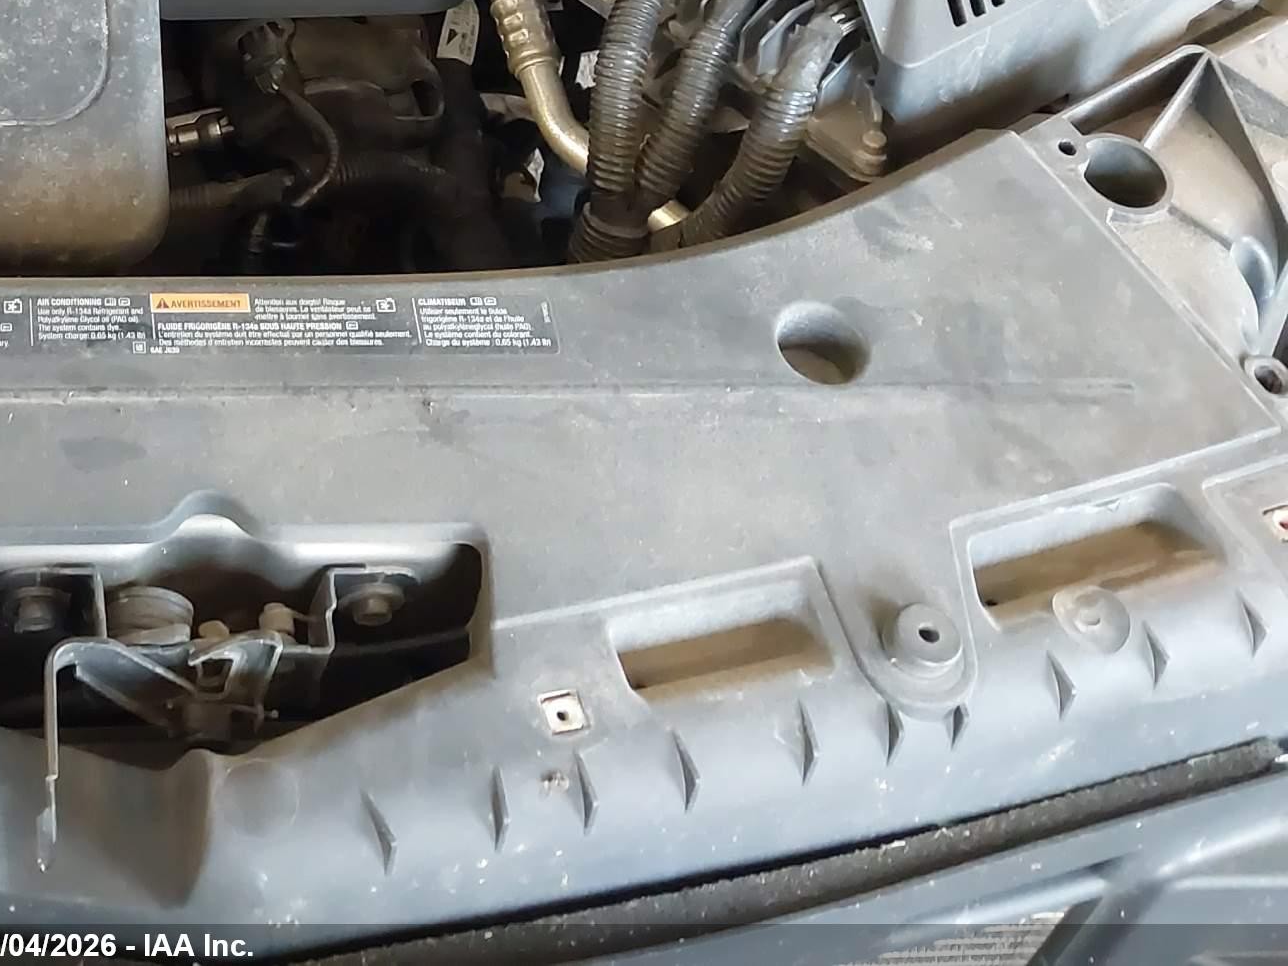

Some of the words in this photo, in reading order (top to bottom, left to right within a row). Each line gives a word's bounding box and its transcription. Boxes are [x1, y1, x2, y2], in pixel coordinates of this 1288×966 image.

[37, 298, 50, 307] AIR
[51, 298, 102, 307] CONDITIONING
[171, 299, 241, 309] AVERTISSEMENT
[418, 298, 466, 306] CLIMATISEUR
[37, 307, 50, 315] Use
[51, 307, 65, 316] only
[66, 307, 91, 315] R-134a
[92, 307, 130, 316] Refrigerant
[130, 307, 144, 315] and
[255, 306, 264, 314] de
[79, 315, 100, 324] Glycol
[101, 315, 110, 323] oil
[458, 316, 484, 324] R-134a
[38, 323, 51, 331] The
[52, 324, 76, 332] system
[77, 323, 106, 331] contains
[106, 323, 120, 332] dye.
[157, 322, 183, 331] FLUIDE
[232, 322, 259, 331] R-134a
[260, 322, 280, 330] SOUS
[281, 322, 305, 331] HAUTE
[305, 322, 342, 331] PRESSION
[38, 332, 63, 341] System
[107, 332, 117, 340] kg
[314, 331, 348, 339] personnel
[492, 330, 502, 338] du
[158, 339, 172, 347] Des
[335, 338, 349, 346] des
[450, 339, 461, 347] du
[512, 339, 522, 348] kg
